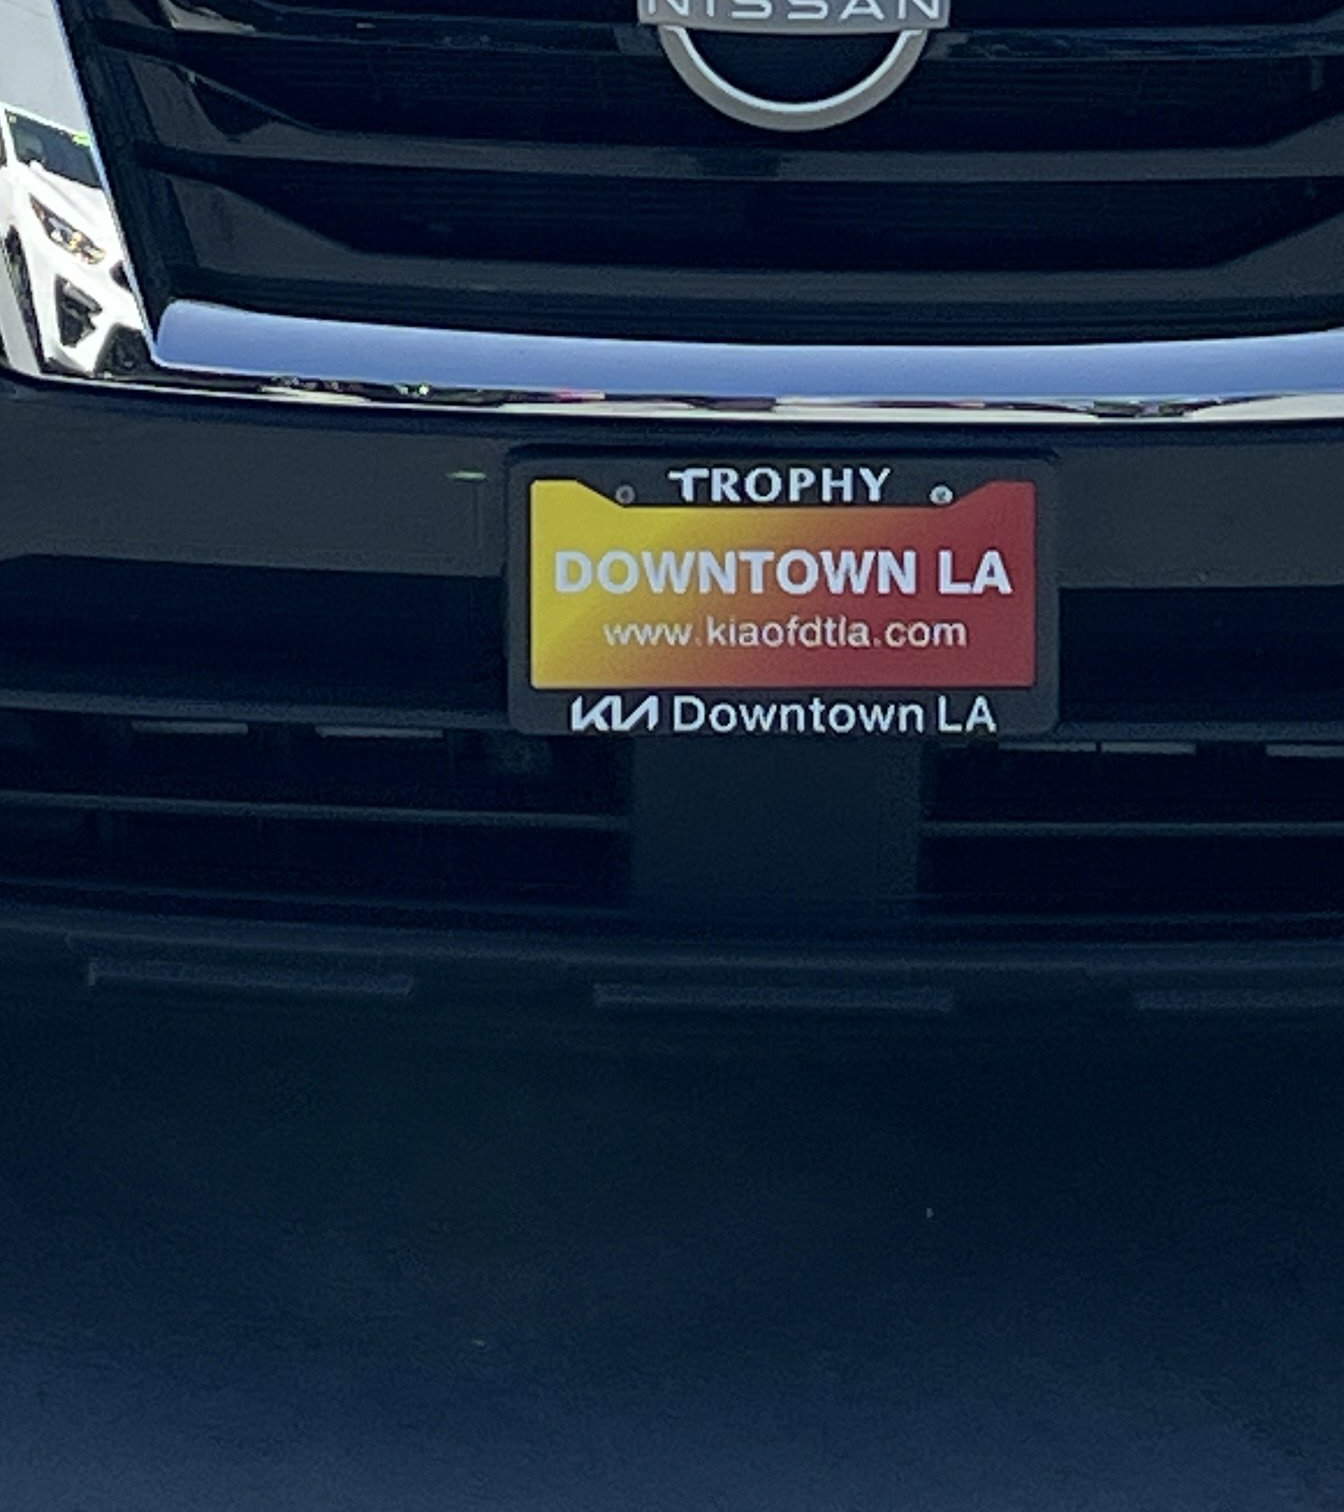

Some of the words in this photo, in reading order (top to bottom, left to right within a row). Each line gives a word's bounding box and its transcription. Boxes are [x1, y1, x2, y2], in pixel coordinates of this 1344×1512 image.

[668, 467, 891, 503] TROPHY
[554, 550, 917, 595] DOWNTOWN
[937, 550, 1013, 595] LA
[602, 615, 968, 649] www.kiaofdtla.com
[673, 695, 926, 733] Downtown
[937, 695, 997, 733] LA
